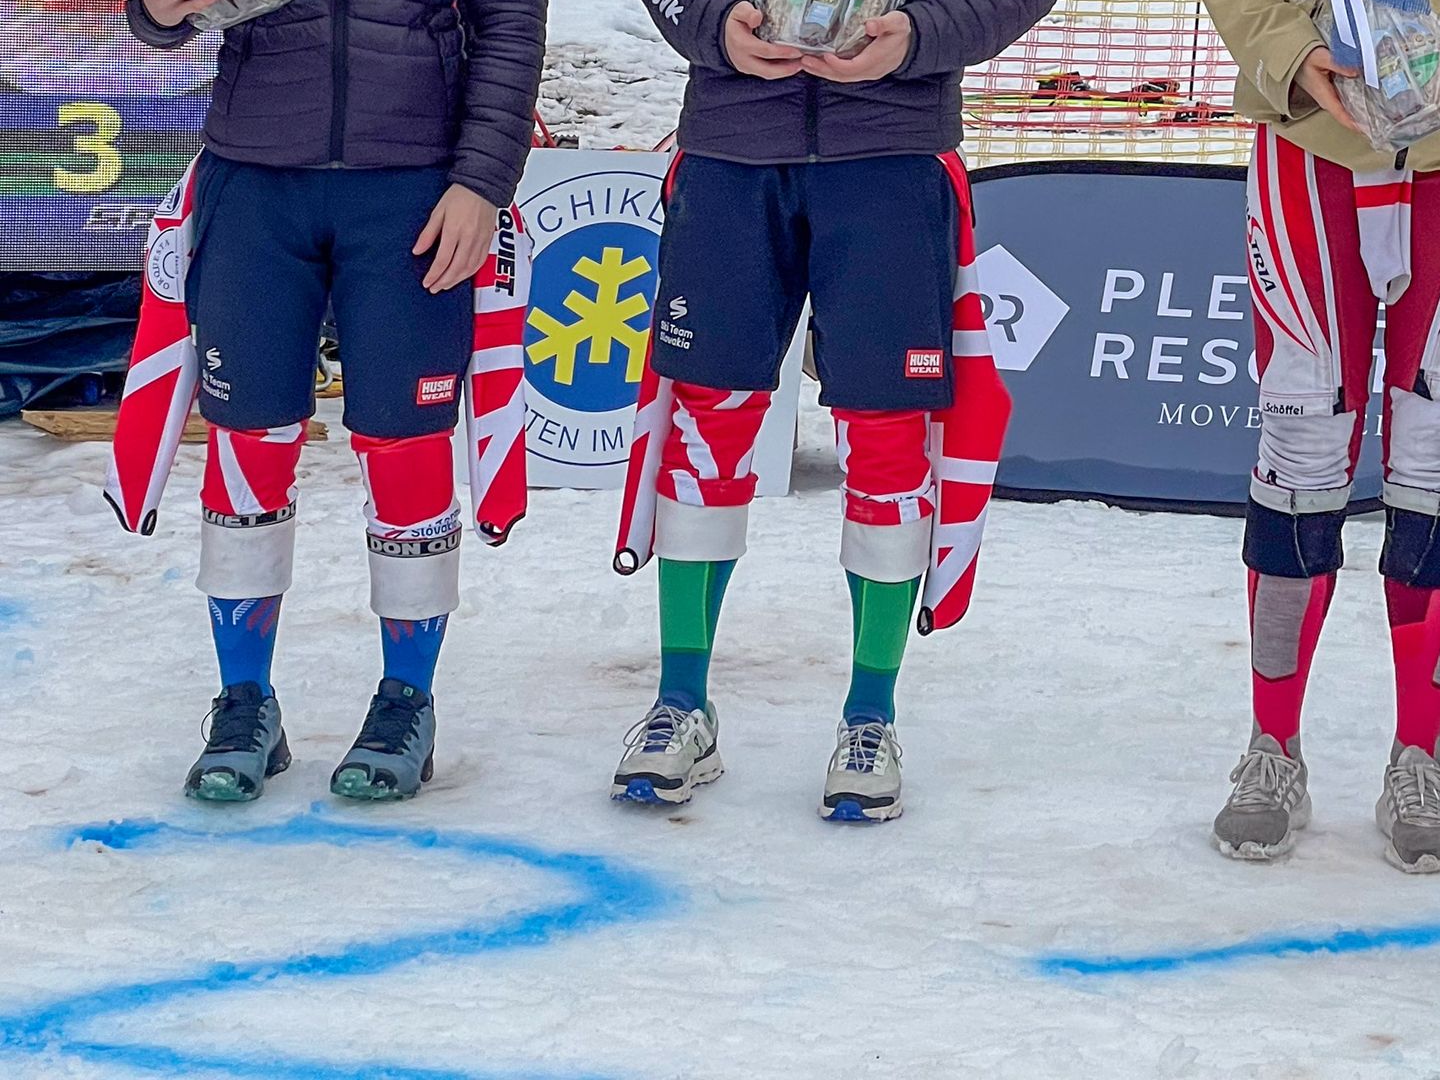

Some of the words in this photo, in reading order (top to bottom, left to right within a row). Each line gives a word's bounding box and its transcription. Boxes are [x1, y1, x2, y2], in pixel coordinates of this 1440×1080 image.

[53, 101, 123, 194] 3
[494, 208, 516, 297] QUIET
[670, 324, 694, 340] Team
[660, 331, 692, 351] Slovakia
[909, 353, 940, 367] HUSKI
[1090, 332, 1260, 385] RES
[909, 366, 940, 374] WEAR
[209, 374, 231, 392] Team
[422, 378, 454, 394] HUSKI
[421, 391, 453, 402] WEAR
[1265, 402, 1304, 416] Schöffel
[370, 536, 421, 556] DON
